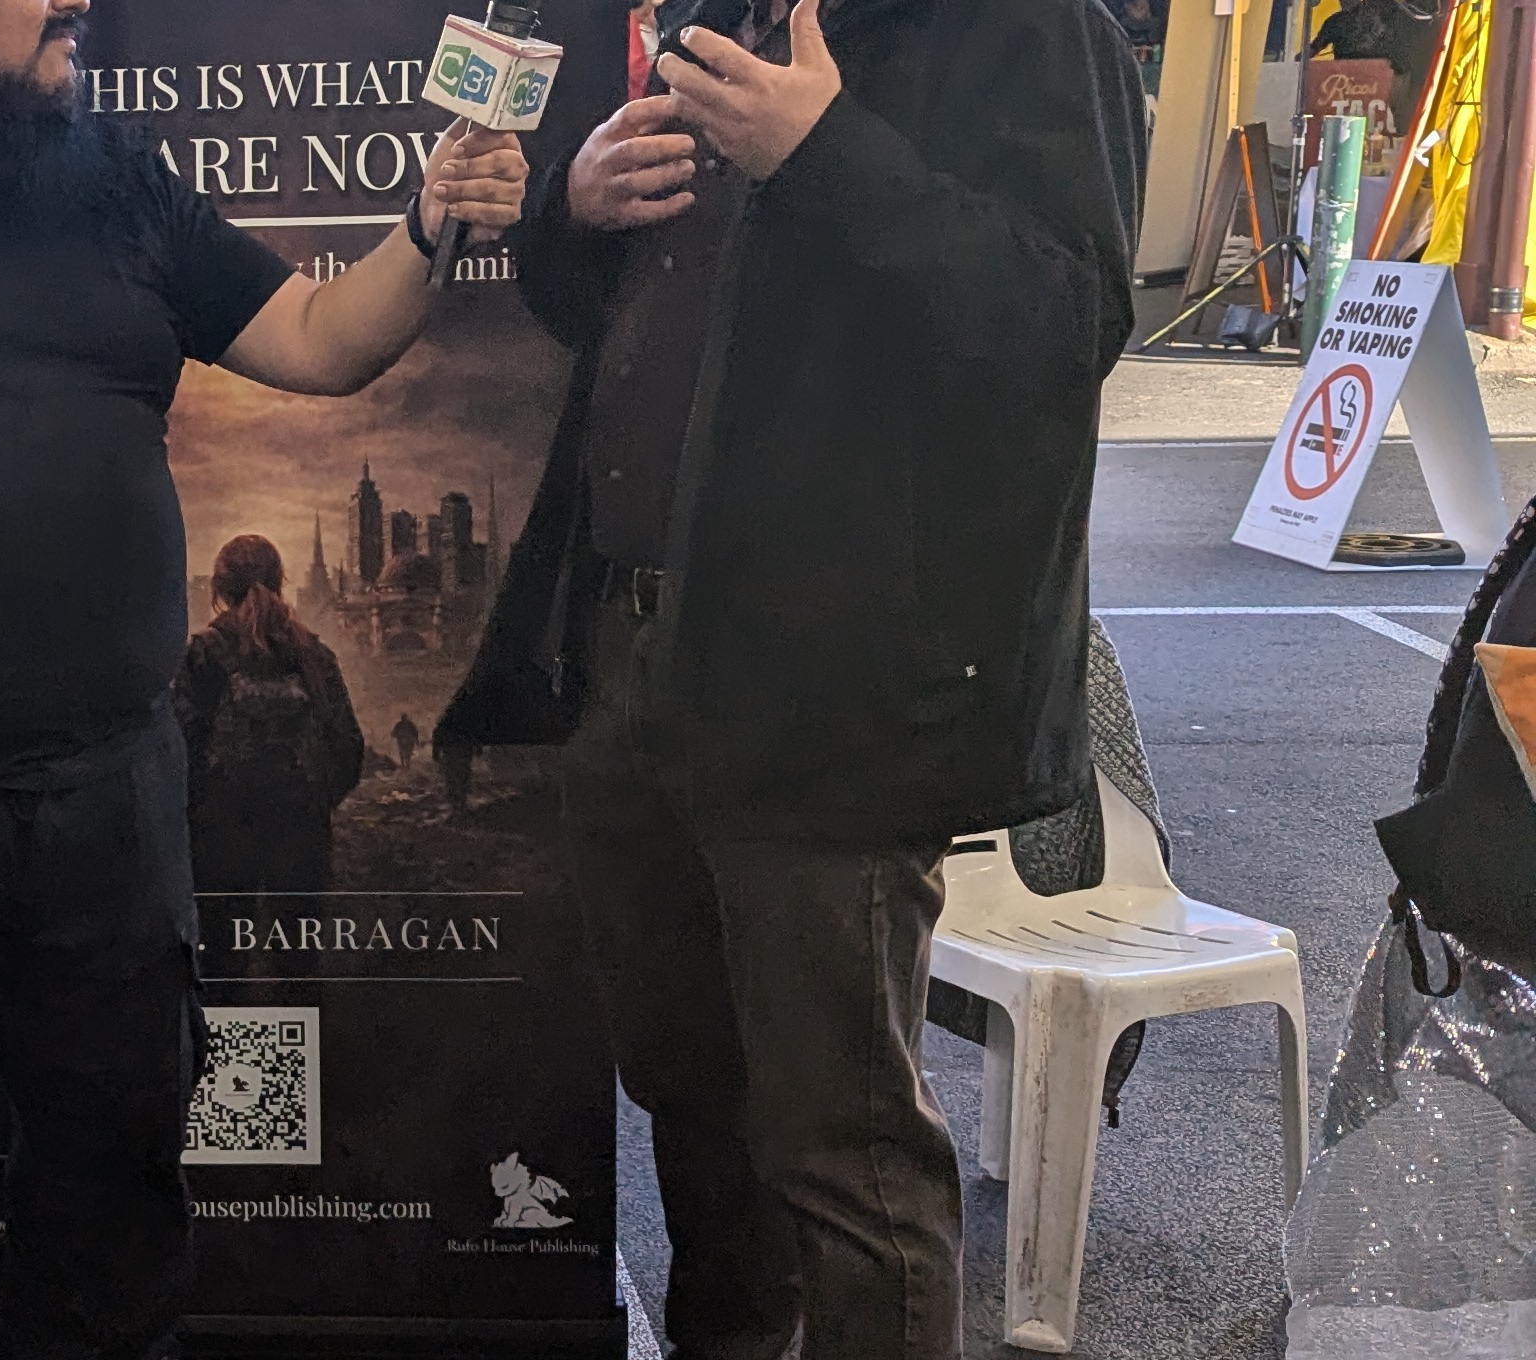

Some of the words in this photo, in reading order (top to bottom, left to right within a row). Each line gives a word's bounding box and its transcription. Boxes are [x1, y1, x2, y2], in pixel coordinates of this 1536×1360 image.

[82, 65, 179, 113] HIS
[197, 64, 244, 110] IS
[256, 59, 424, 108] WHAT
[1372, 274, 1401, 298] NO
[1335, 300, 1418, 330] SMOKING
[1319, 327, 1341, 351] OR
[1347, 330, 1413, 360] VAPING
[231, 916, 502, 951] BARRAGAN
[530, 1237, 599, 1256] Publishing
